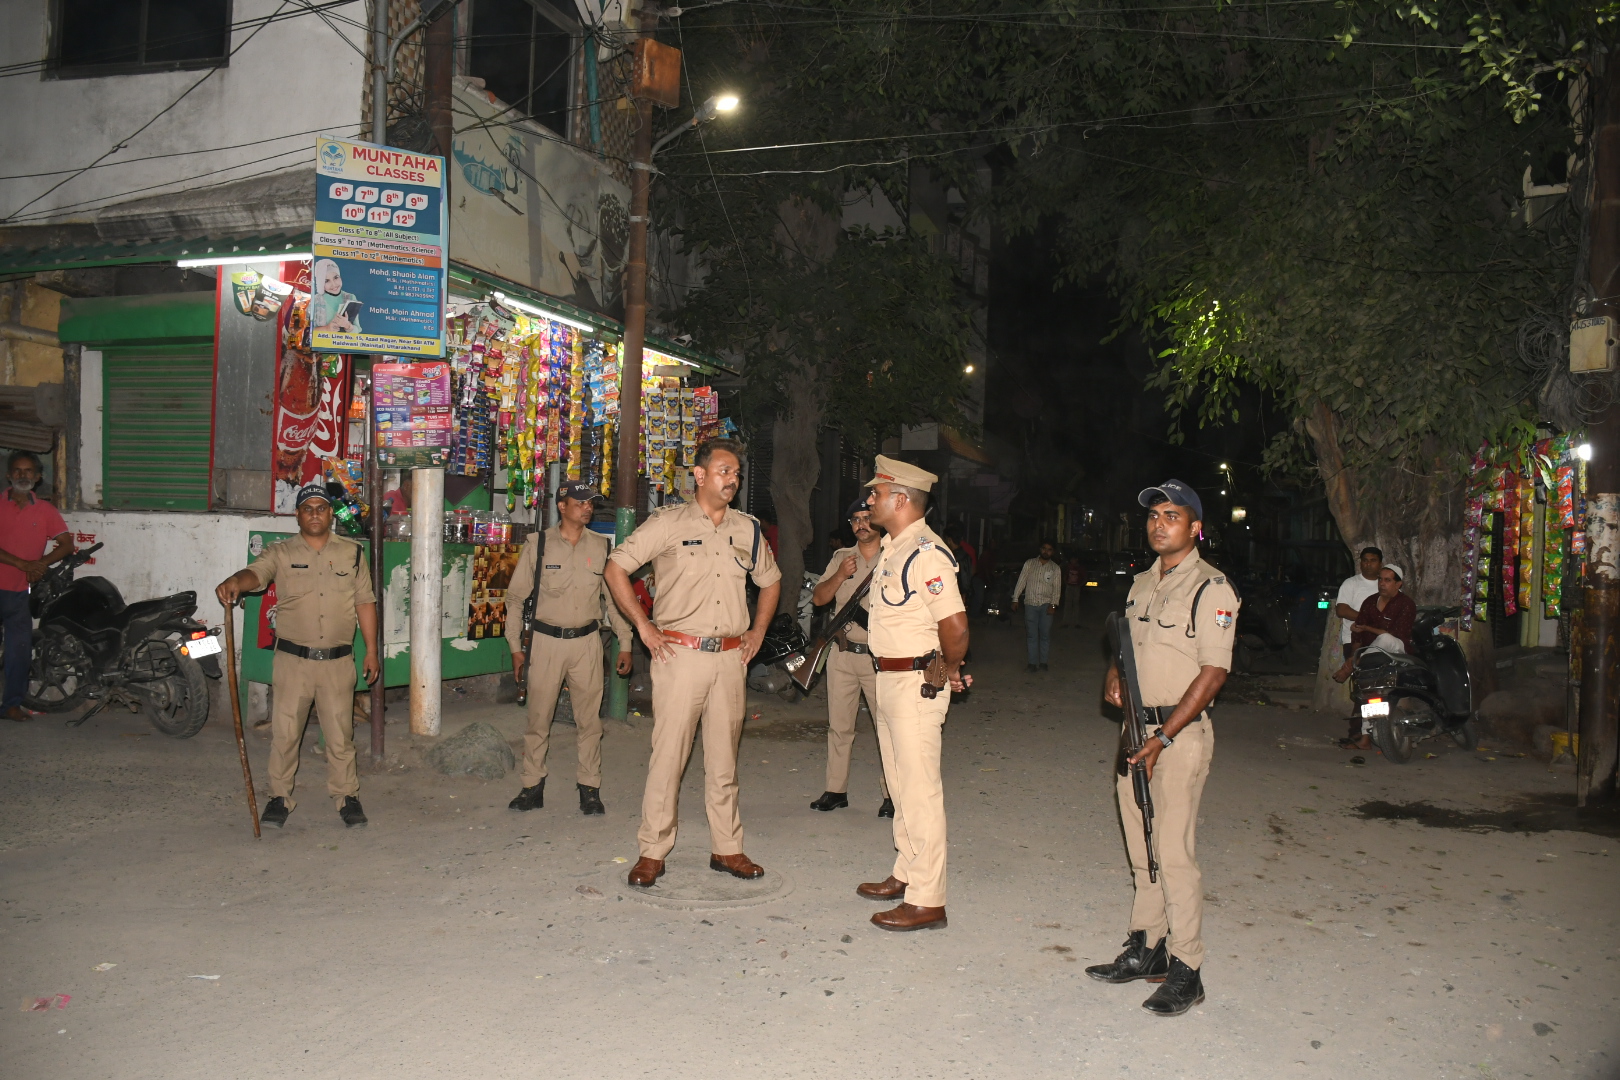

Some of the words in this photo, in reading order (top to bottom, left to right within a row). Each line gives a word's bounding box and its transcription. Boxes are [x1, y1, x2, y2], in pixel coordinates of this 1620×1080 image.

[352, 146, 438, 172] MUNTAHA
[366, 165, 425, 182] CLASSES
[335, 186, 348, 197] 6th
[361, 189, 374, 200] 7th
[386, 193, 399, 203] 8th
[411, 196, 424, 206] 9th
[345, 207, 364, 218] 10th
[370, 210, 389, 221] 11th
[395, 214, 414, 224] 12th
[394, 233, 419, 241] Subject)
[412, 246, 436, 255] Science)
[380, 254, 425, 265] (Mathematics)
[392, 270, 416, 279] Shuaib
[301, 487, 325, 496] POLICE
